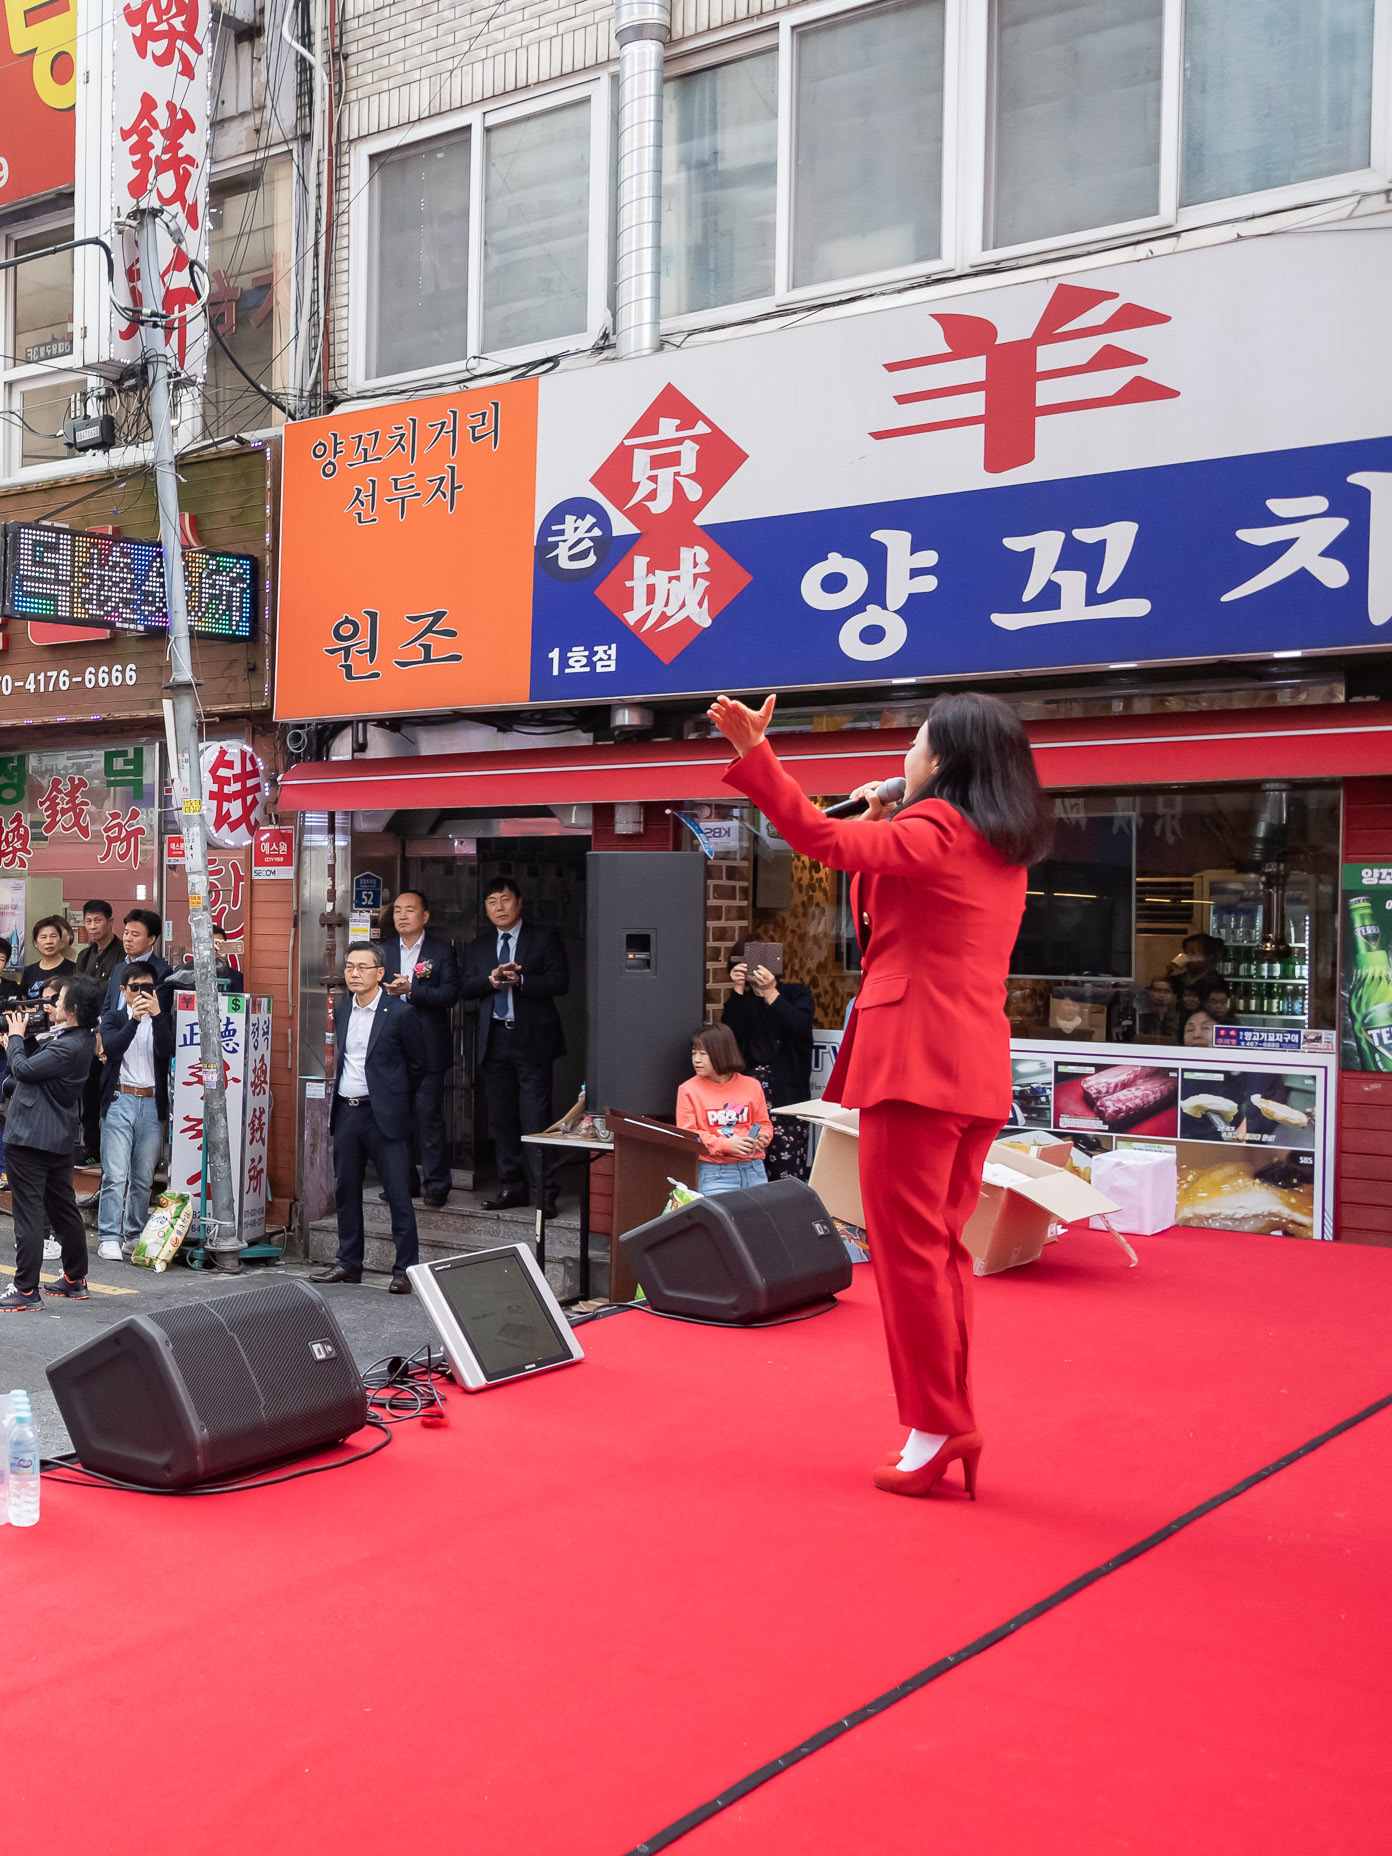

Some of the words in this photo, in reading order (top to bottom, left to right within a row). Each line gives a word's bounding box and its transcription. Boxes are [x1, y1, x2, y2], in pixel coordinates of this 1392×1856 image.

[869, 283, 1181, 474] 羊
[311, 400, 503, 480] 양꼬치거리
[346, 463, 464, 527] 선두자
[546, 515, 598, 572] 老
[802, 470, 1392, 663] 양꼬치
[547, 643, 618, 676] 1호점
[104, 747, 143, 801] 덕
[208, 745, 262, 838] 钱
[253, 868, 276, 877] SECOM
[260, 842, 288, 856] 에스원
[361, 891, 373, 905] 52
[245, 1053, 268, 1196] 換錢所
